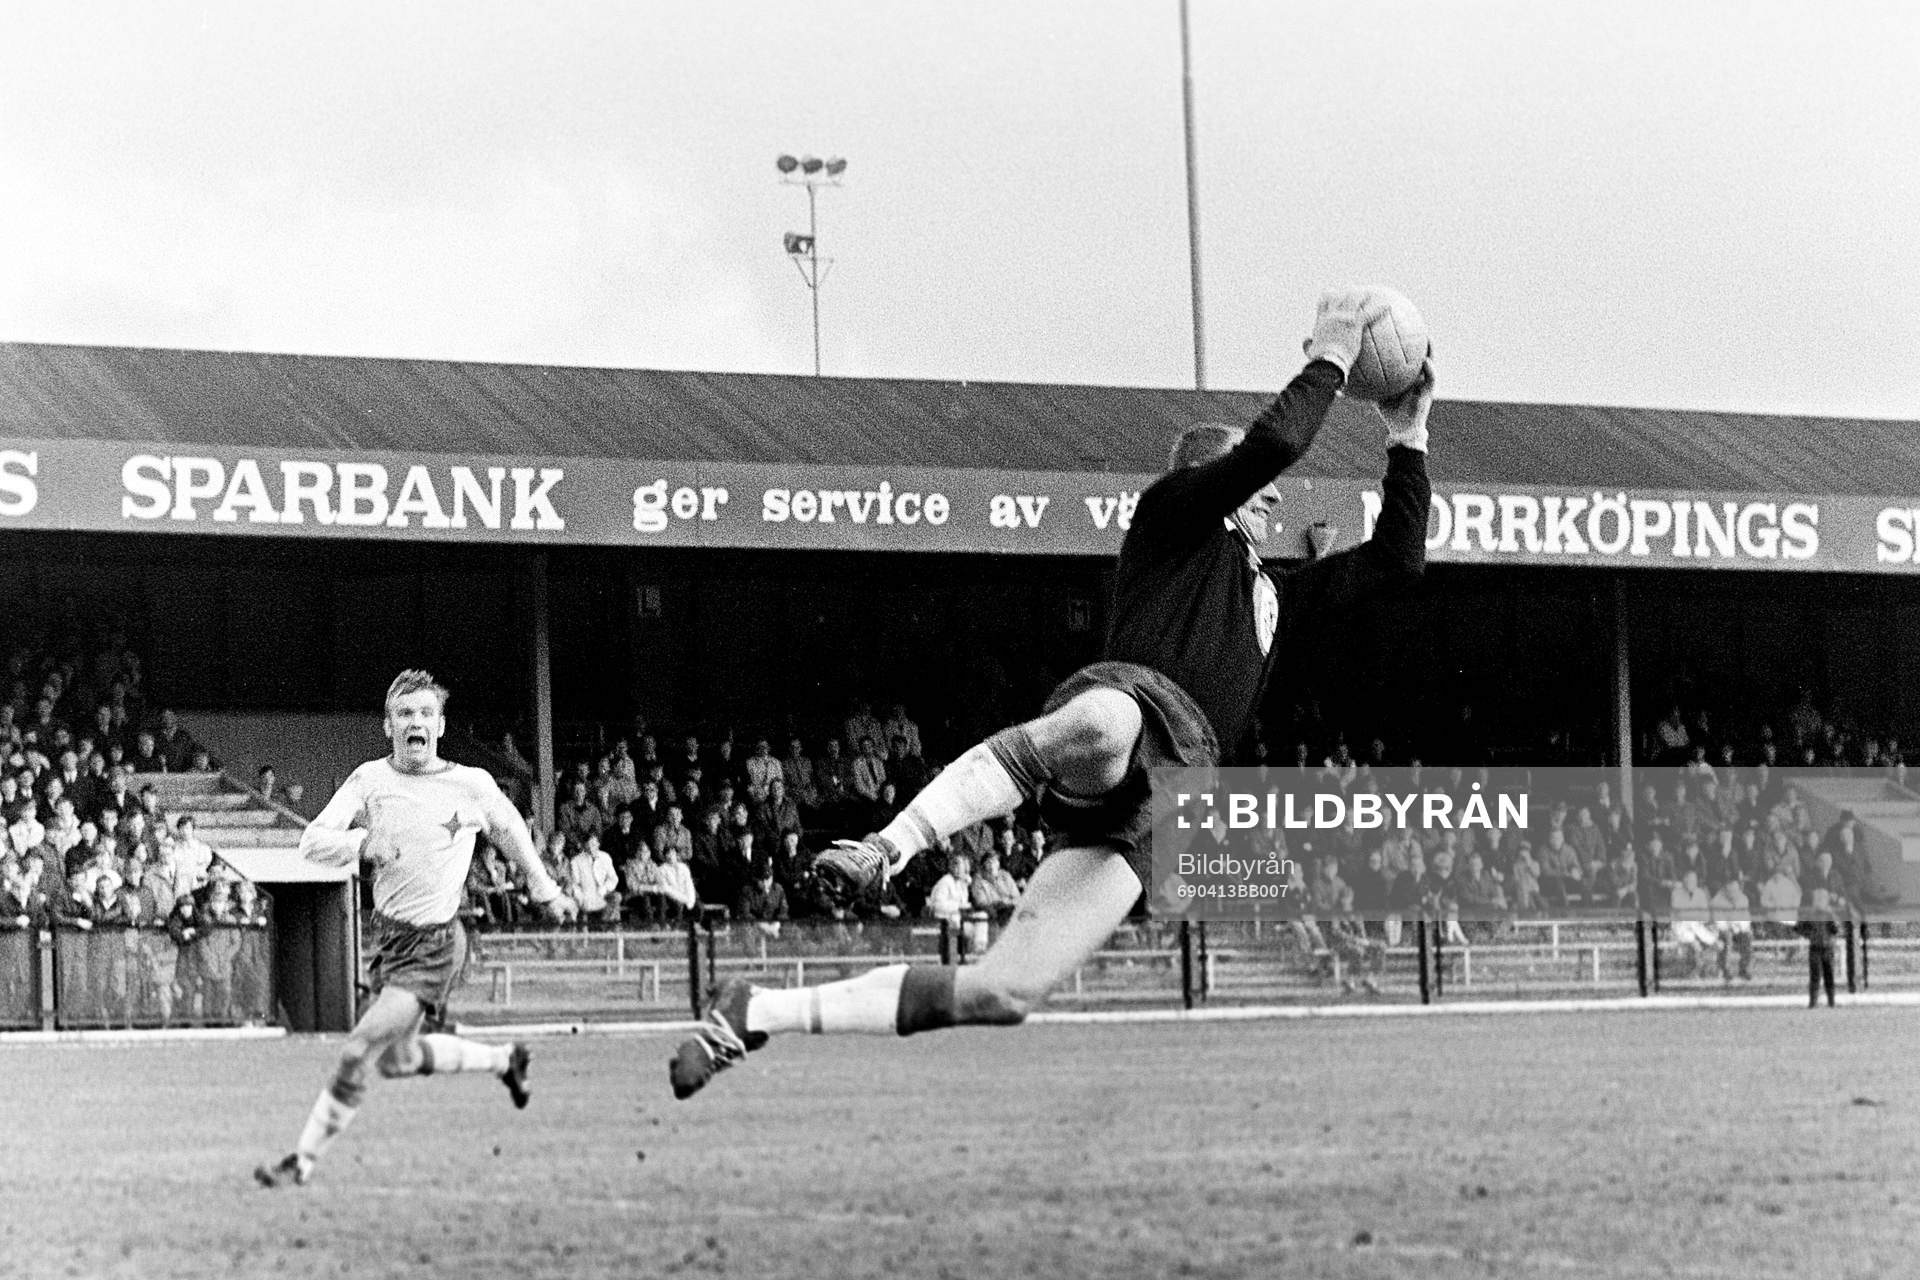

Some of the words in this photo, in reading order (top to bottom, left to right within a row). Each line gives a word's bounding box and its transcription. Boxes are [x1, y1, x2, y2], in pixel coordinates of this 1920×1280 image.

[121, 455, 565, 530] SPARBANK
[633, 479, 728, 532] ger
[762, 481, 949, 525] service
[989, 495, 1049, 528] av
[1876, 507, 1920, 564] S
